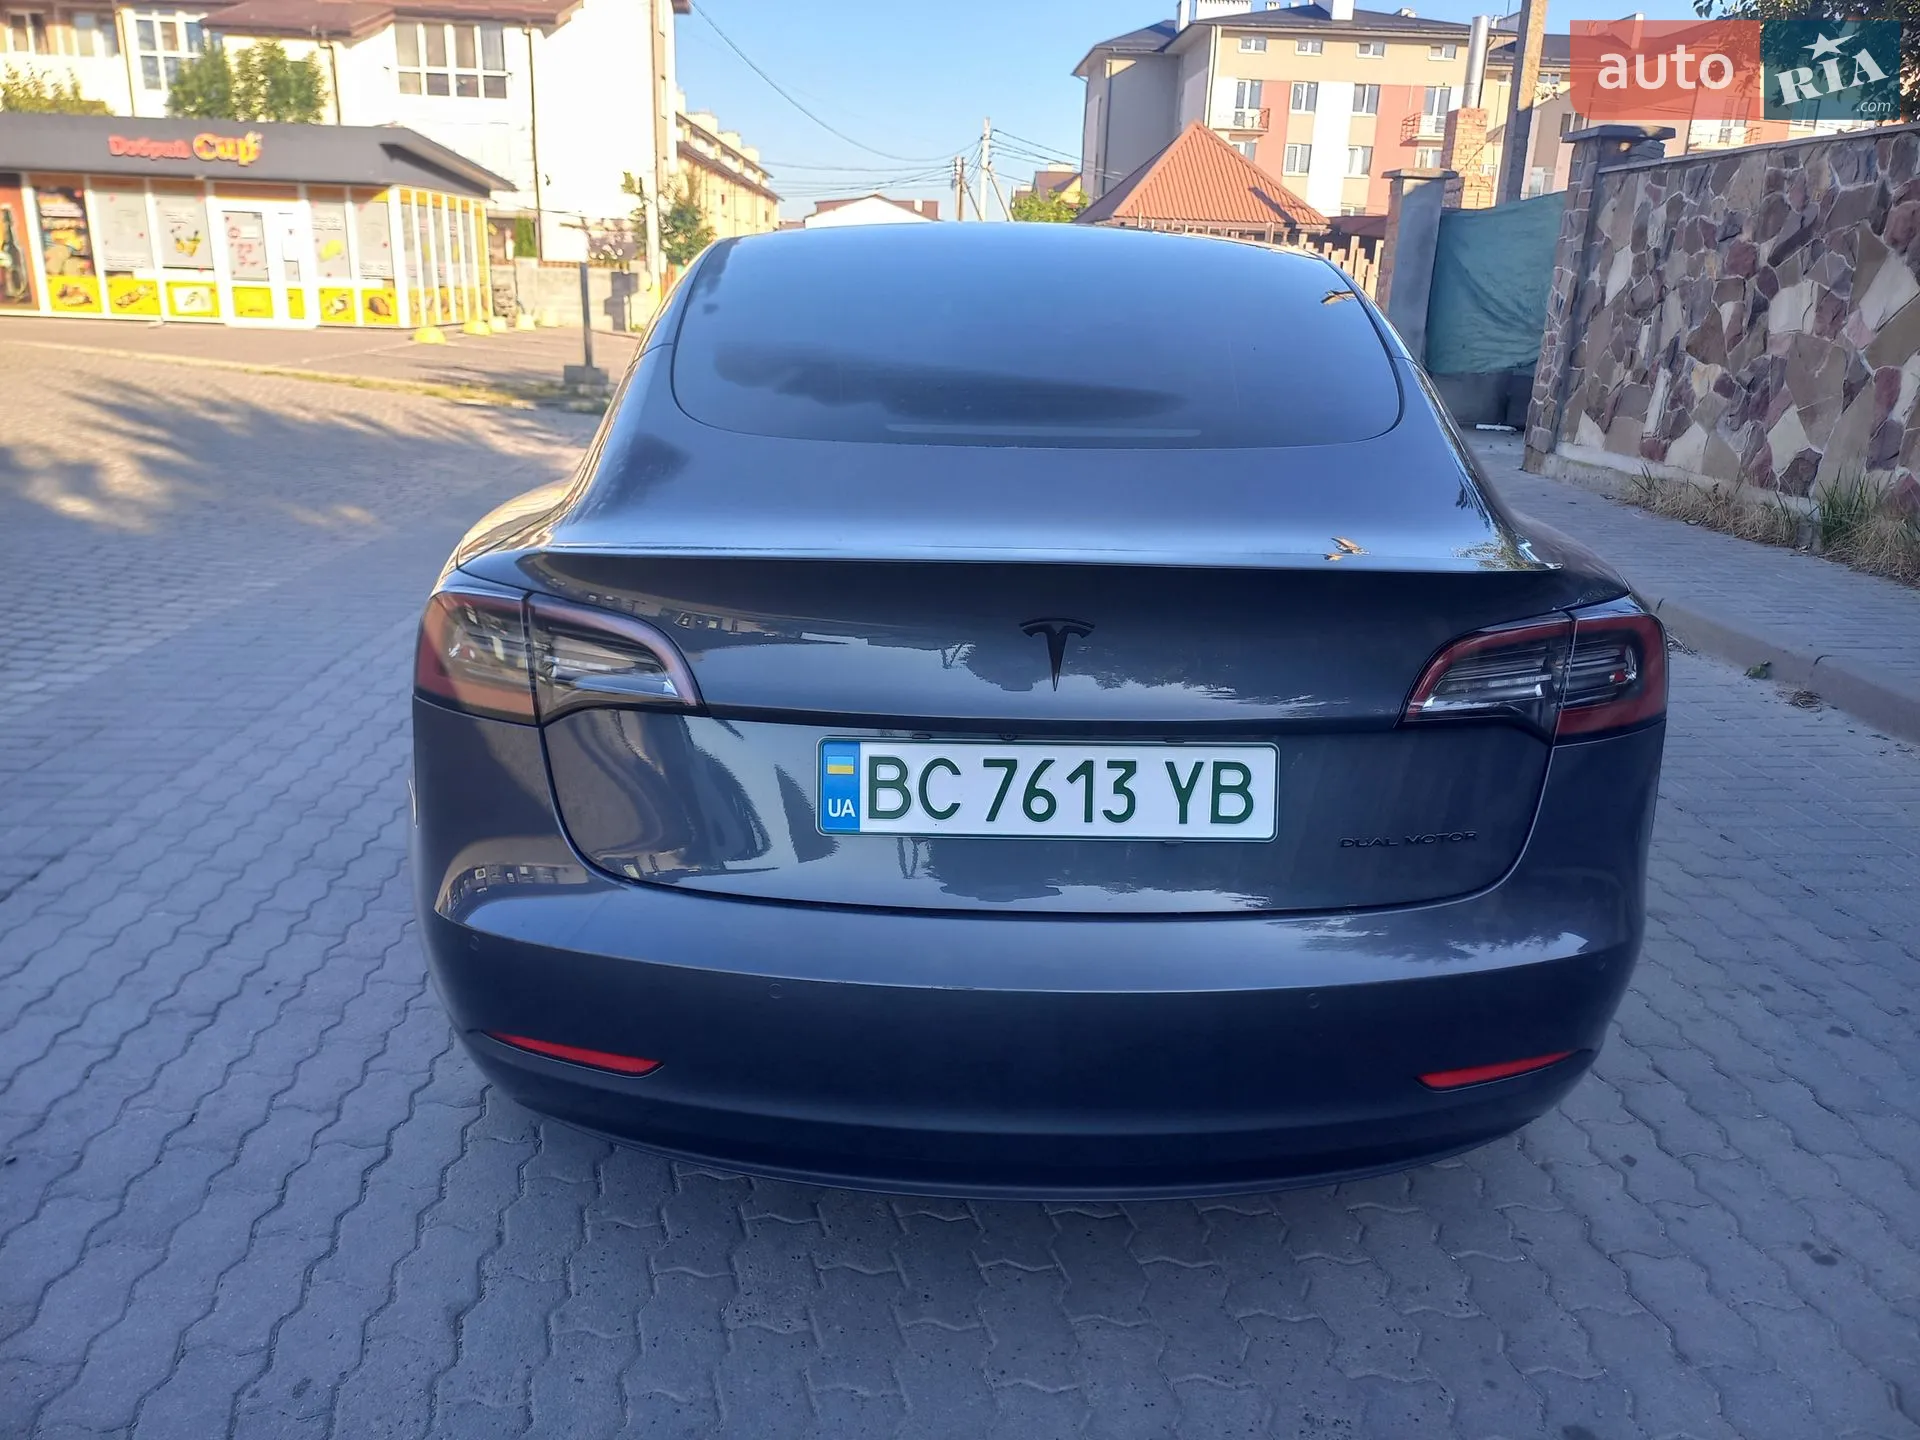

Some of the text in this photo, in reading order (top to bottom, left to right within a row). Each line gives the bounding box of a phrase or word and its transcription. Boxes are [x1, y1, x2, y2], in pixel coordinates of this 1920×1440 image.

[868, 755, 1255, 824] BC 7613 YB
[827, 797, 856, 818] UA
[1339, 831, 1478, 848] DUAL MOTOR
